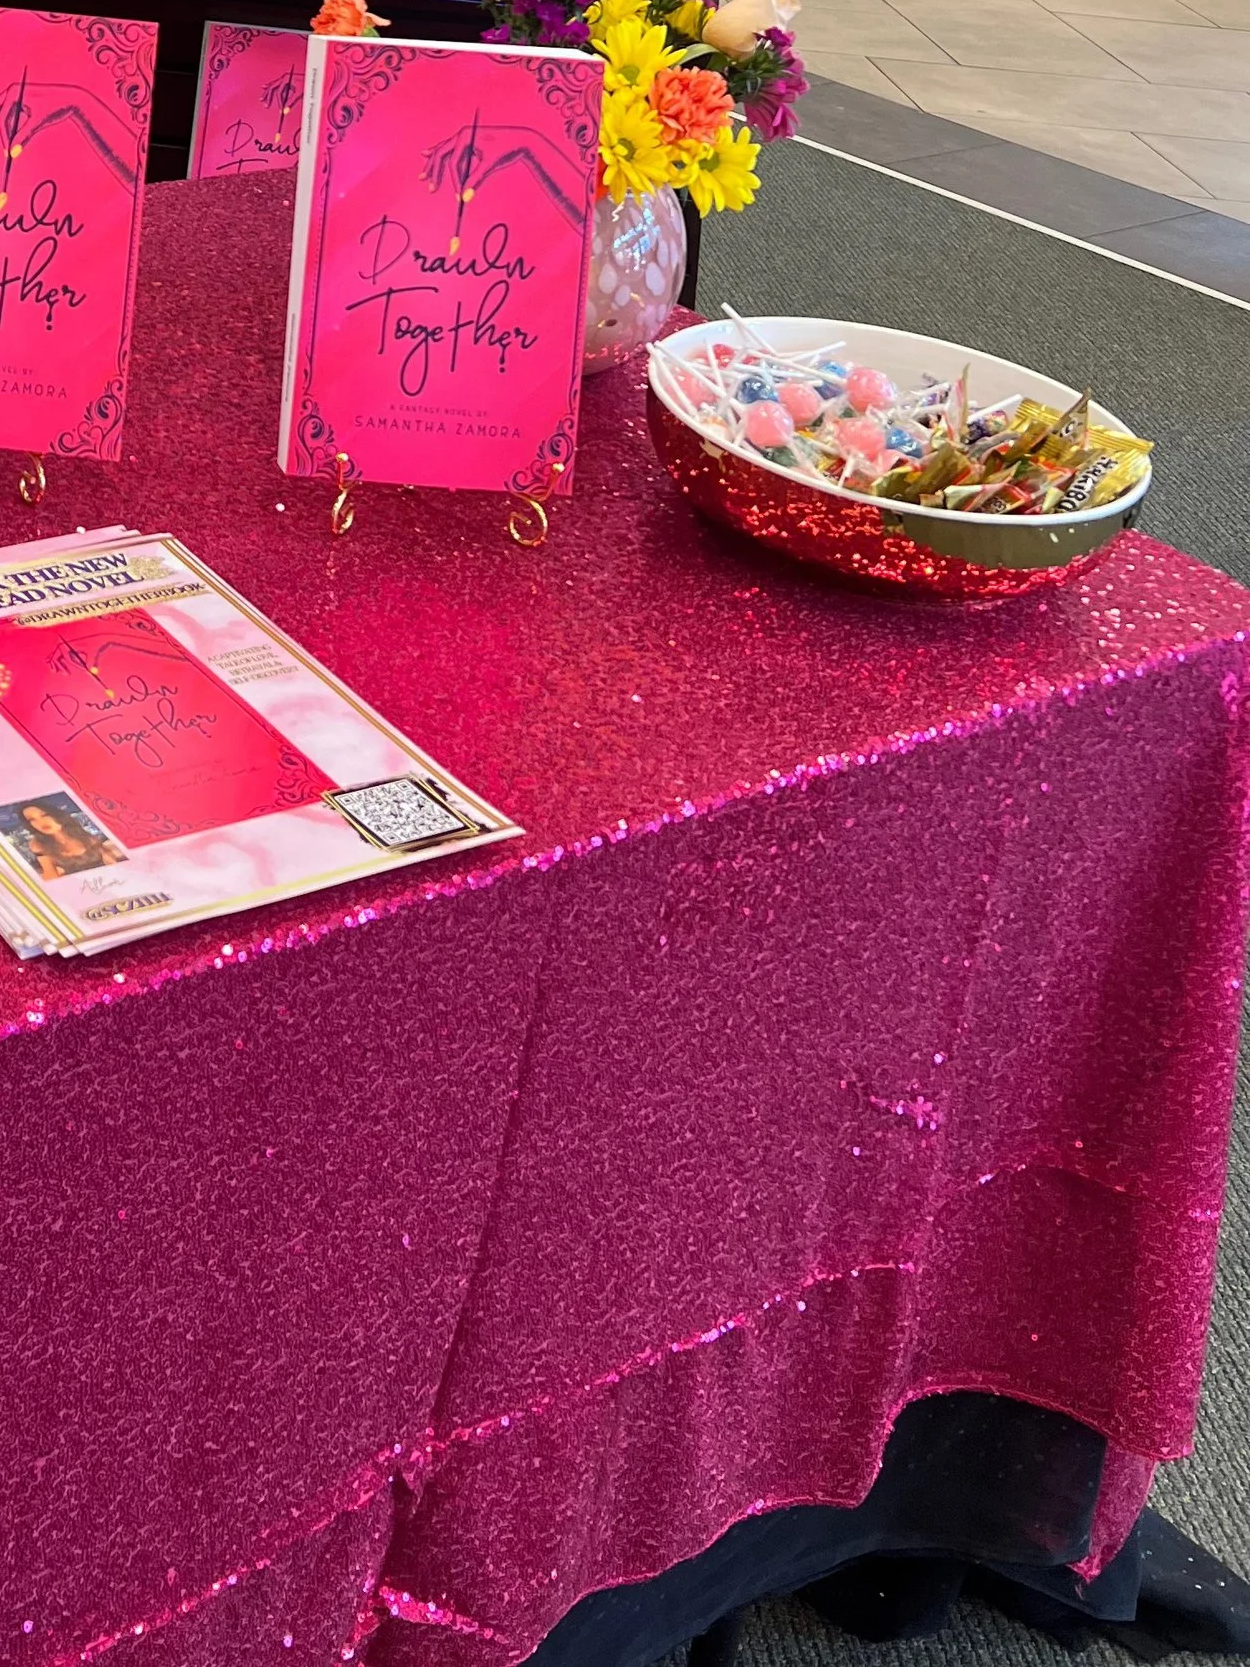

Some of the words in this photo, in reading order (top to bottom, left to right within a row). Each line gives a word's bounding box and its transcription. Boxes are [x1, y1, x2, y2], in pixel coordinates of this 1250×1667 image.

[358, 214, 535, 287] Drawn
[345, 279, 539, 399] Together
[0, 377, 69, 400] ZAMORA
[354, 415, 446, 436] SAMANTHA
[454, 420, 522, 441] ZAMORA
[3, 564, 66, 588] THE
[66, 552, 131, 577] NEW
[42, 570, 146, 603] NOVEL
[39, 675, 180, 730] Drawn
[65, 699, 220, 768] Together
